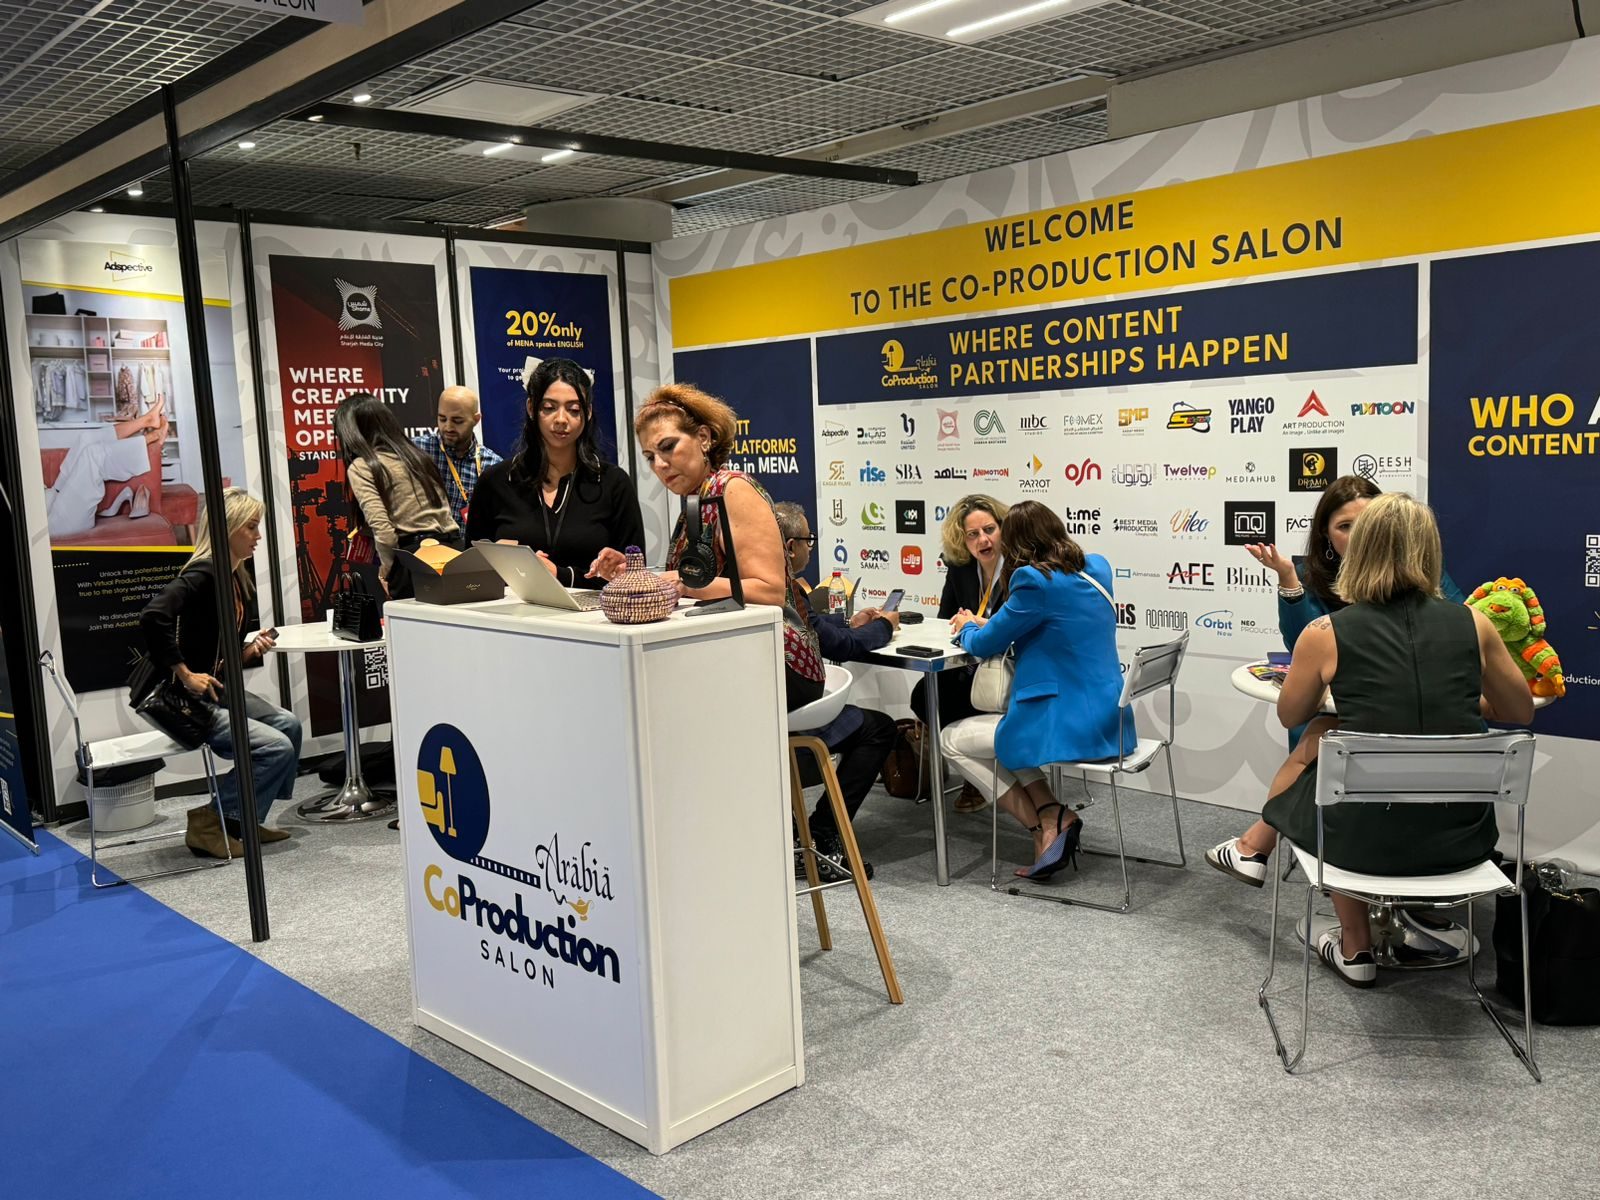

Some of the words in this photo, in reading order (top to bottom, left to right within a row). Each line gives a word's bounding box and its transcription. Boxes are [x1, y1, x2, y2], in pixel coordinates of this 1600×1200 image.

[985, 200, 1134, 253] WELCOME
[104, 261, 153, 273] Adspective
[851, 288, 880, 316] TO
[888, 281, 931, 310] THE
[941, 239, 1197, 303] CO-PRODUCTION
[1211, 217, 1342, 267] SALON
[949, 327, 1033, 356] WHERE
[1044, 306, 1183, 347] CONTENT
[535, 341, 556, 350] speaks
[950, 346, 1145, 387] PARTNERSHIPS
[1156, 332, 1289, 371] HAPPEN
[289, 367, 364, 384] WHERE
[881, 372, 938, 387] CoProduction
[1228, 397, 1274, 416] YANGO
[1470, 393, 1574, 429] WHO
[294, 409, 336, 425] MEE
[1298, 420, 1344, 428] PRODUCTION
[1230, 416, 1264, 434] PLAY
[822, 429, 849, 438] Adspective
[1468, 433, 1600, 457] CONTENT
[743, 457, 755, 473] in
[759, 456, 799, 473] MENA
[860, 460, 886, 482] rise
[895, 464, 922, 480] SBA
[972, 468, 1009, 478] ANIMOTION
[1225, 475, 1276, 483] MEDIAHUB
[1019, 480, 1051, 489] PARROT
[1297, 478, 1328, 486] DRAMA
[1286, 518, 1314, 533] FACT
[122, 568, 133, 576] the
[134, 566, 163, 575] potential
[1226, 567, 1272, 587] Blink
[77, 581, 93, 589] With
[94, 579, 114, 587] Virtual
[115, 577, 140, 585] Product
[101, 587, 113, 595] the
[113, 586, 129, 596] story
[129, 583, 147, 592] while
[121, 593, 141, 602] place
[868, 589, 887, 597] NOON
[99, 613, 110, 622] No
[1203, 618, 1232, 630] Orbit
[1240, 619, 1256, 627] NEO
[88, 623, 103, 632] Join
[103, 621, 115, 629] the
[1240, 626, 1280, 635] PRODUCTIO
[423, 863, 621, 985] CoProduction
[480, 939, 555, 990] SALON
